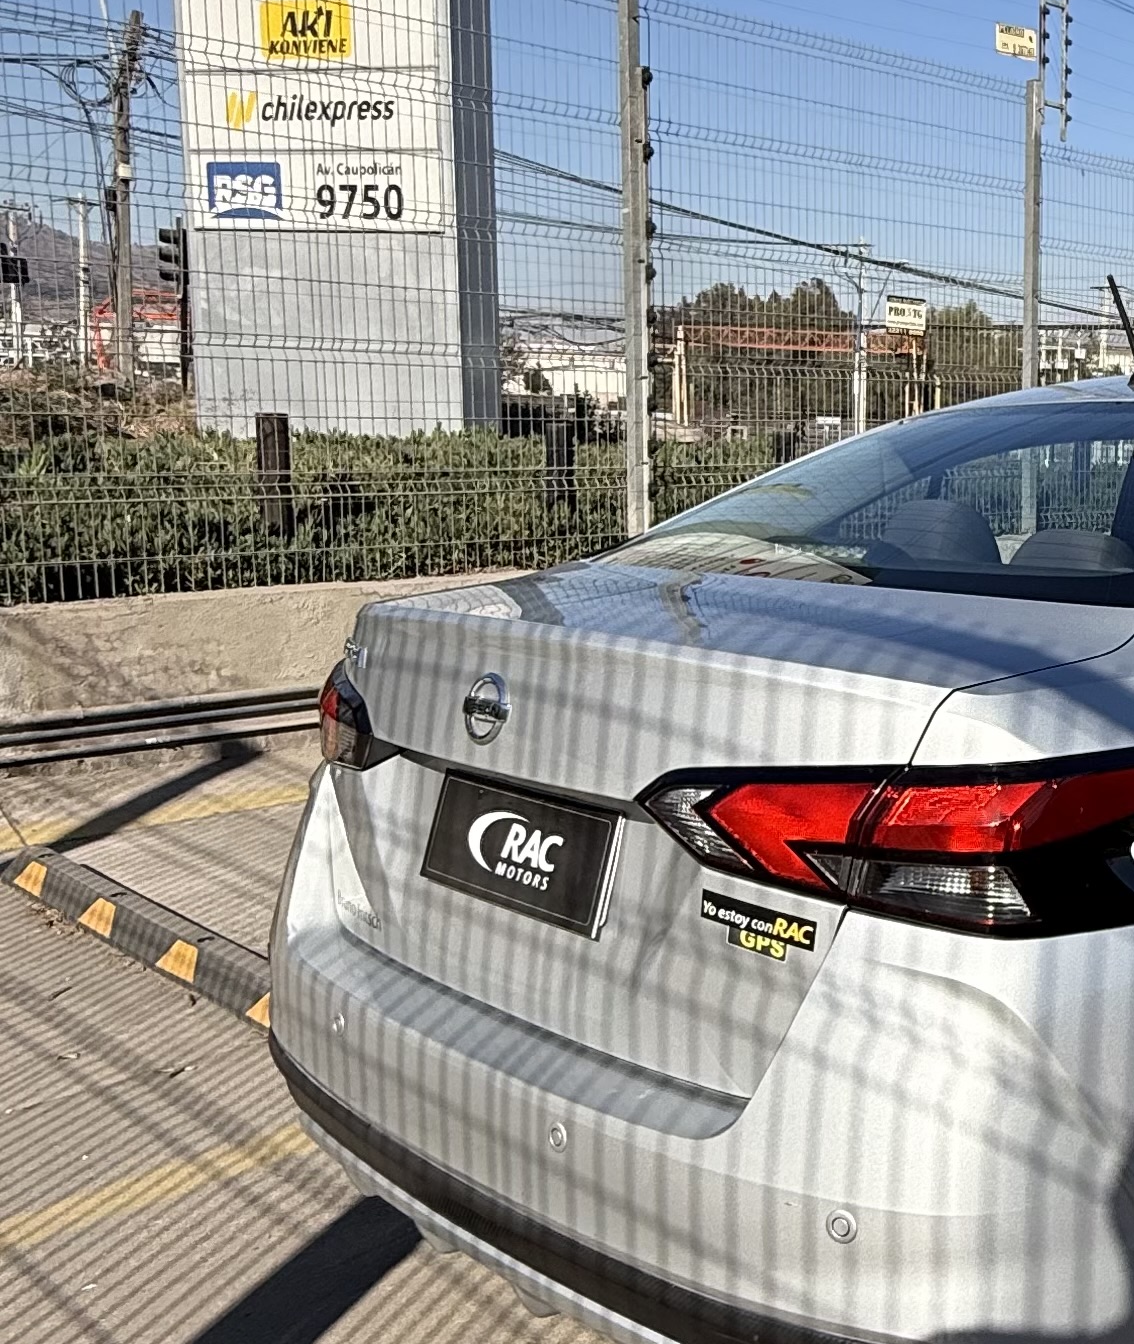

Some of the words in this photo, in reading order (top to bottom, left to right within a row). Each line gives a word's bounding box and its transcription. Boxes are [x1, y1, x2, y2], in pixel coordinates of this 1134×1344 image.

[280, 6, 333, 38] AKI
[268, 38, 347, 56] KONVIENE
[261, 94, 395, 127] chilexpress
[316, 162, 333, 176] Av.
[316, 184, 404, 220] 9750
[500, 822, 564, 872] RAC
[494, 861, 549, 891] MOTORS
[703, 900, 717, 916] Yo
[717, 908, 750, 929] estoy
[751, 918, 773, 934] con
[772, 917, 814, 944] RAC
[739, 930, 785, 958] GPS
